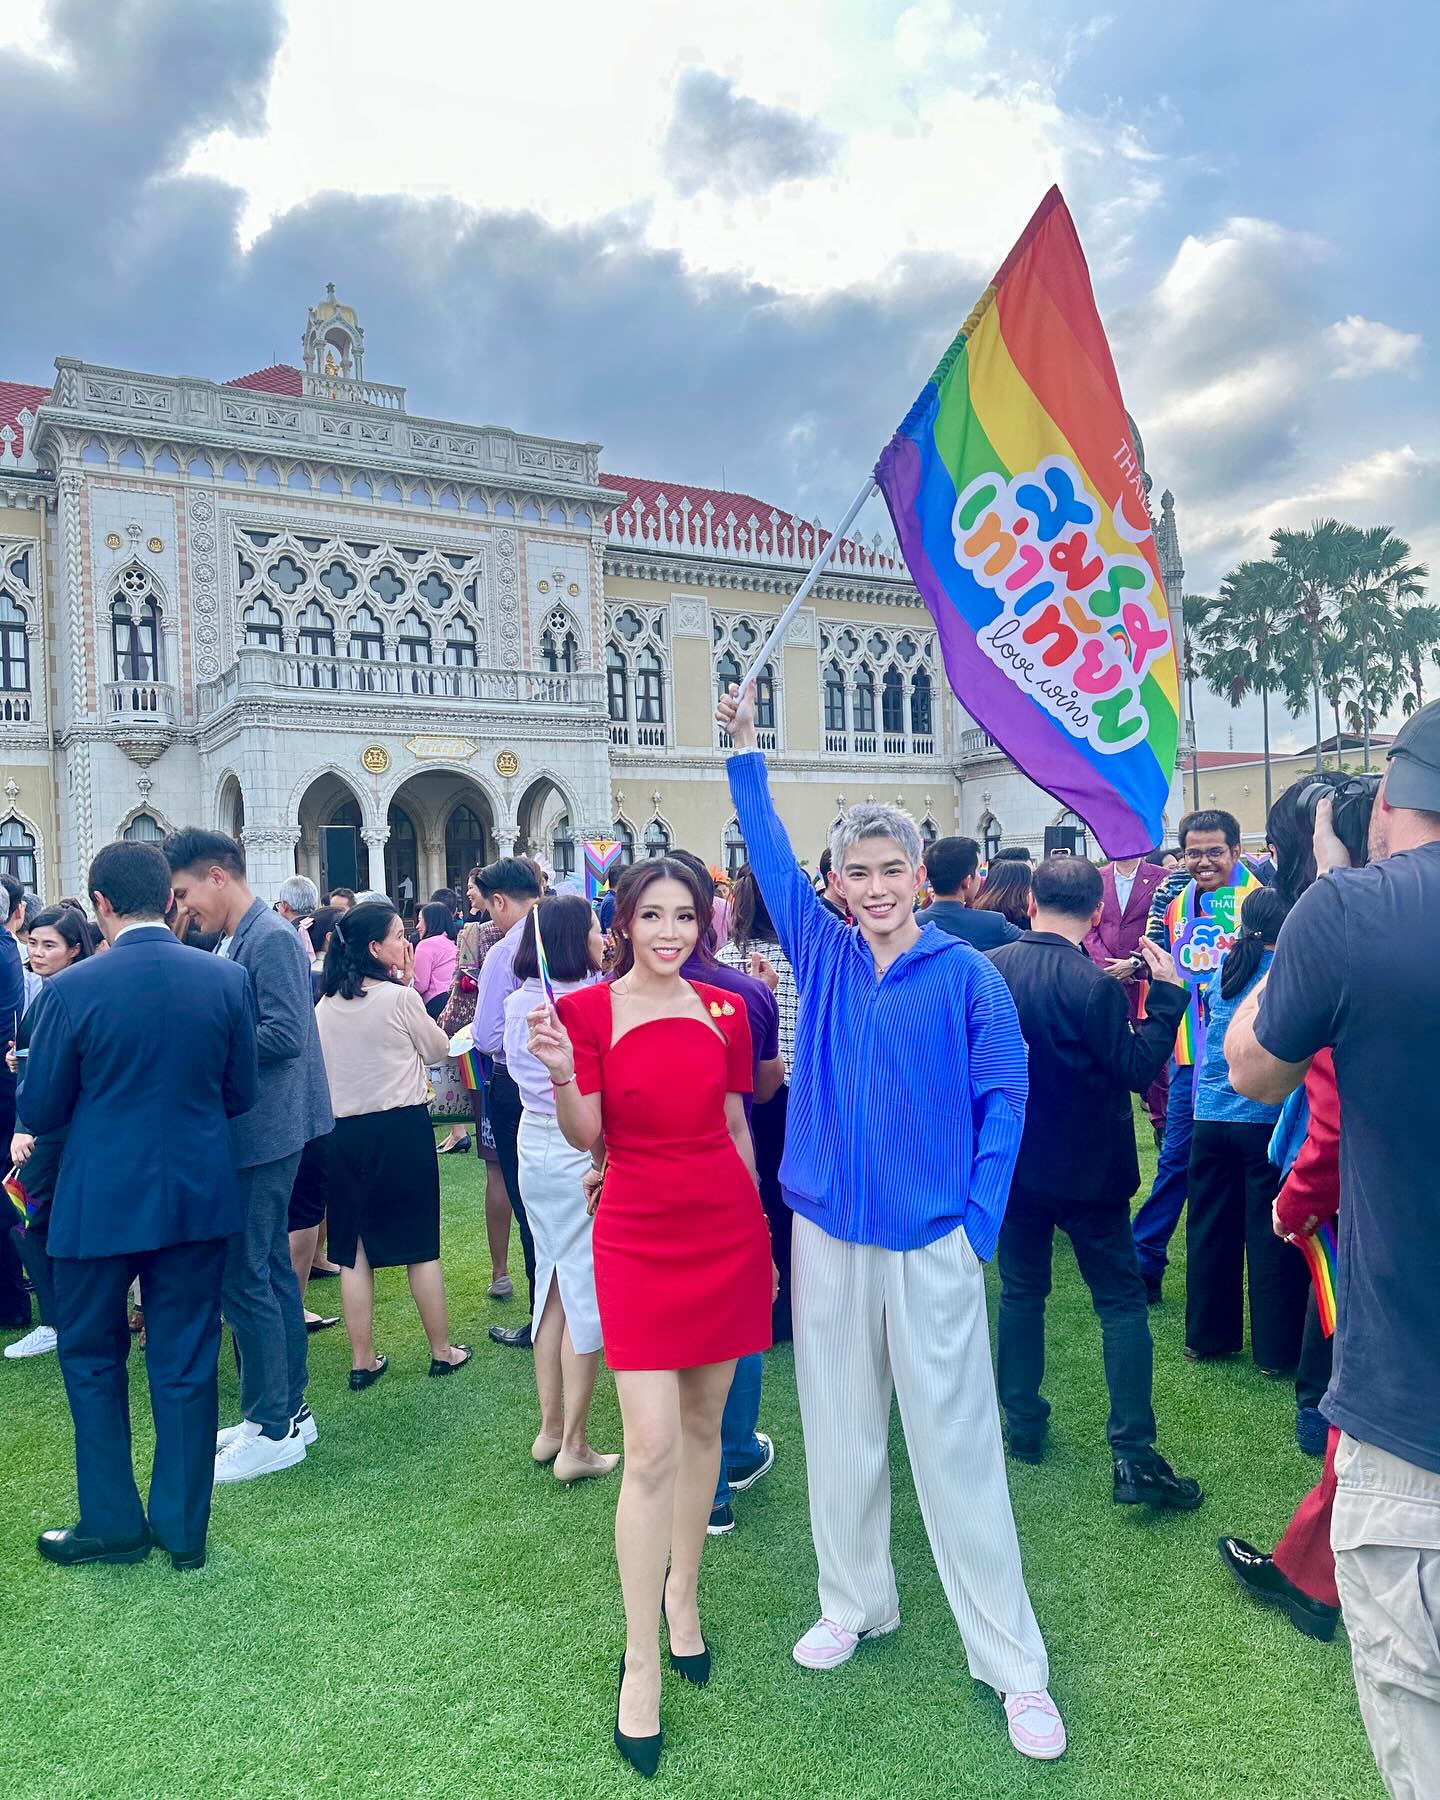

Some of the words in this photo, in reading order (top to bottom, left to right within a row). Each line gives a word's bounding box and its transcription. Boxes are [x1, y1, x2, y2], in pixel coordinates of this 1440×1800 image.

[959, 484, 1142, 743] เท่าเทียม
[1015, 467, 1168, 674] สมรส
[987, 619, 1034, 683] love
[1036, 679, 1088, 727] wins
[1193, 927, 1243, 949] สม
